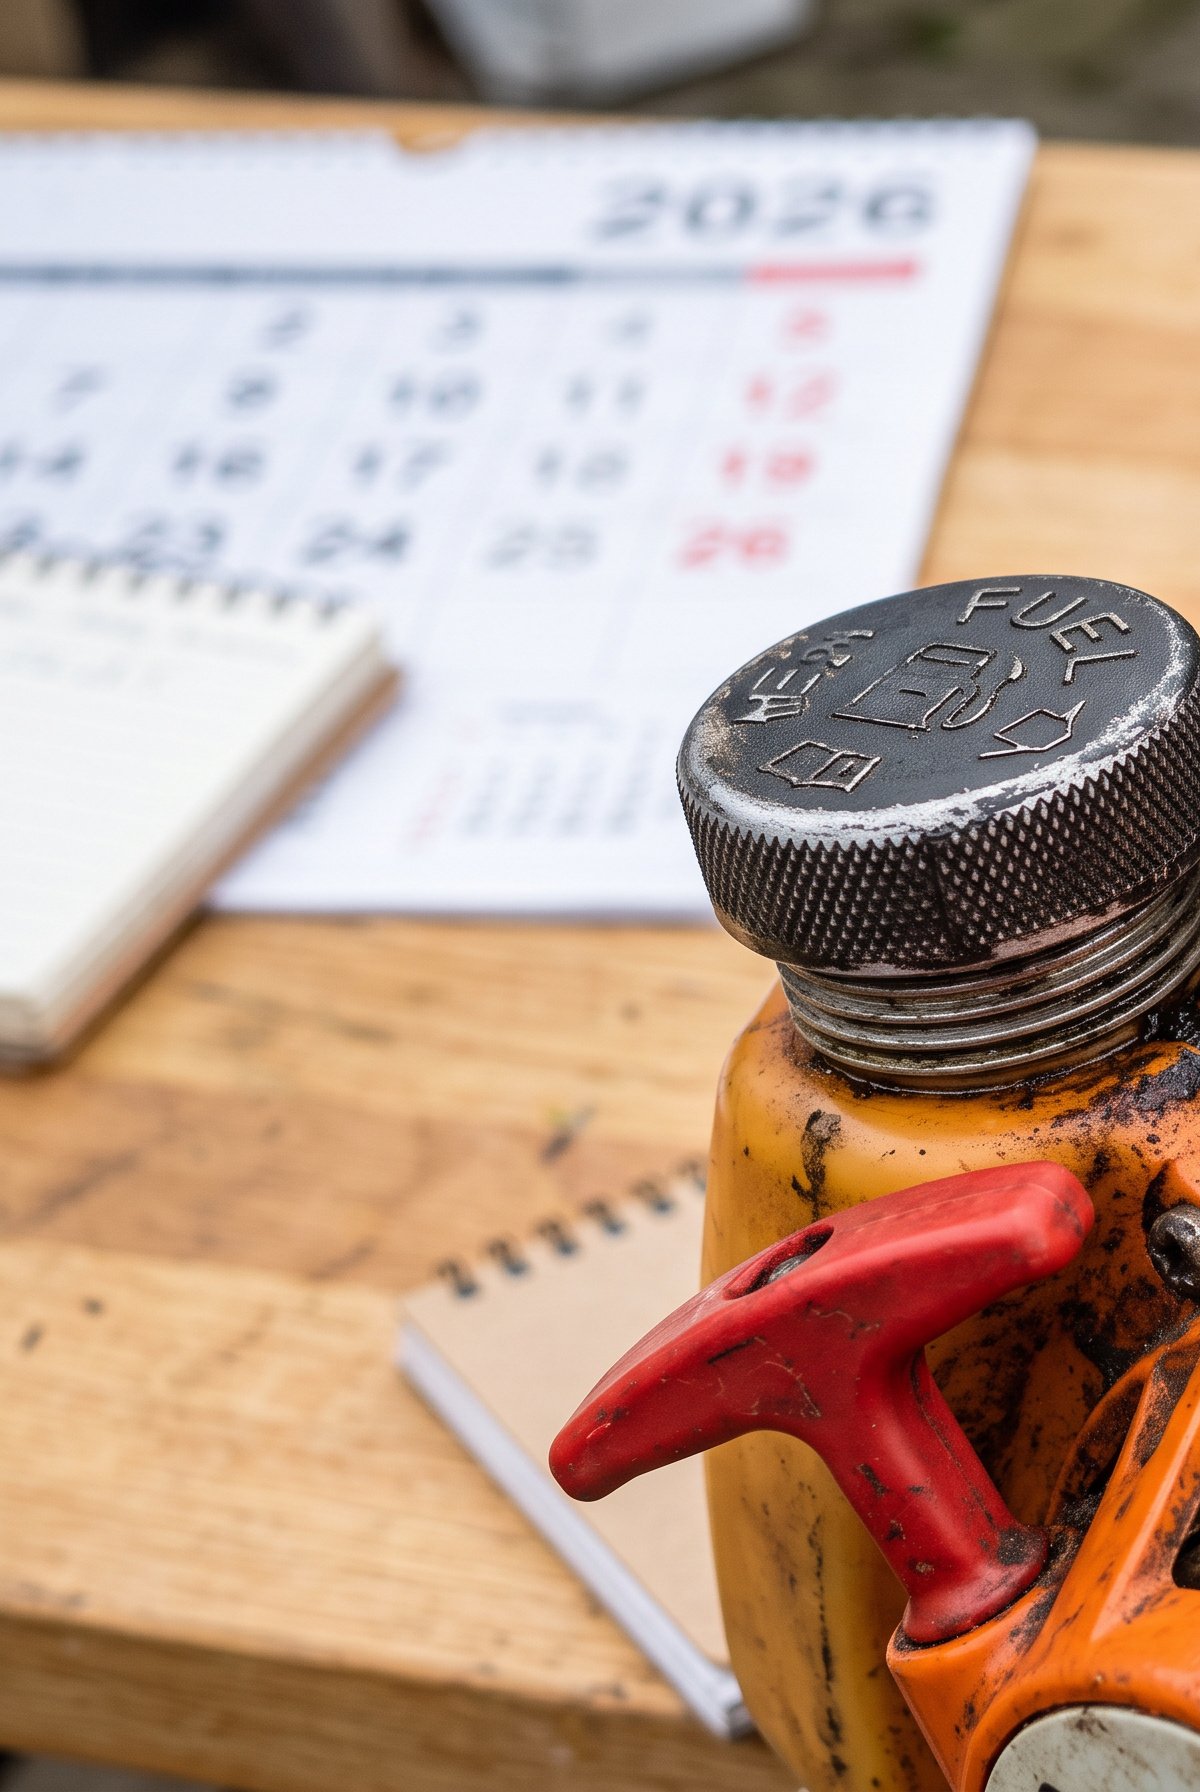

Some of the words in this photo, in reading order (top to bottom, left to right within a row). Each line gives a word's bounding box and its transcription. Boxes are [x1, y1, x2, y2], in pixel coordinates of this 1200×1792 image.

[592, 178, 937, 240] 2026
[384, 371, 482, 417] 10
[560, 372, 647, 417] 11
[741, 369, 838, 418] 12
[350, 442, 452, 490] 17
[715, 443, 818, 490] 19
[674, 520, 794, 570] 26
[955, 585, 1139, 685] FUEL
